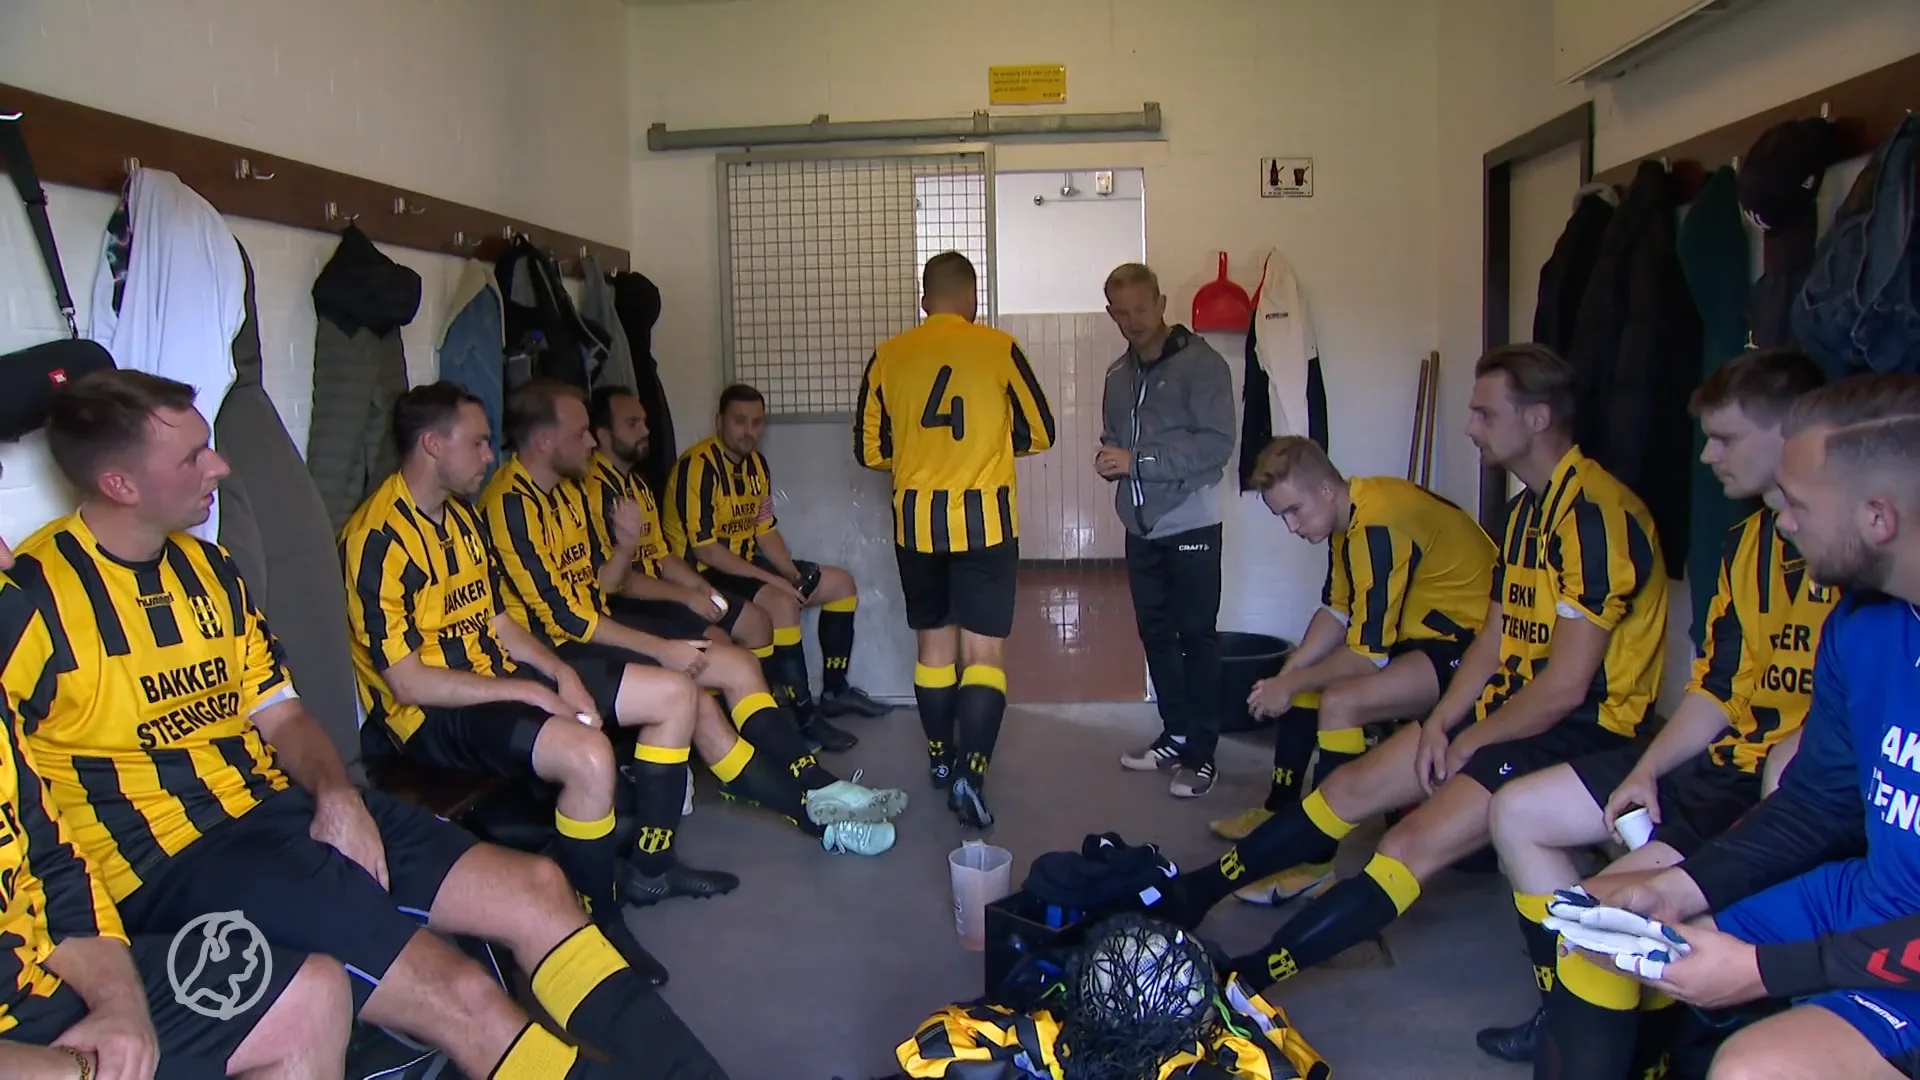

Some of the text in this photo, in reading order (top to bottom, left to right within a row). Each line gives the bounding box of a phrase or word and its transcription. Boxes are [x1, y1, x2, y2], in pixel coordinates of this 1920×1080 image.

[921, 364, 965, 442] 4
[139, 656, 229, 704] BAKKER
[136, 691, 240, 750] STEENGOED
